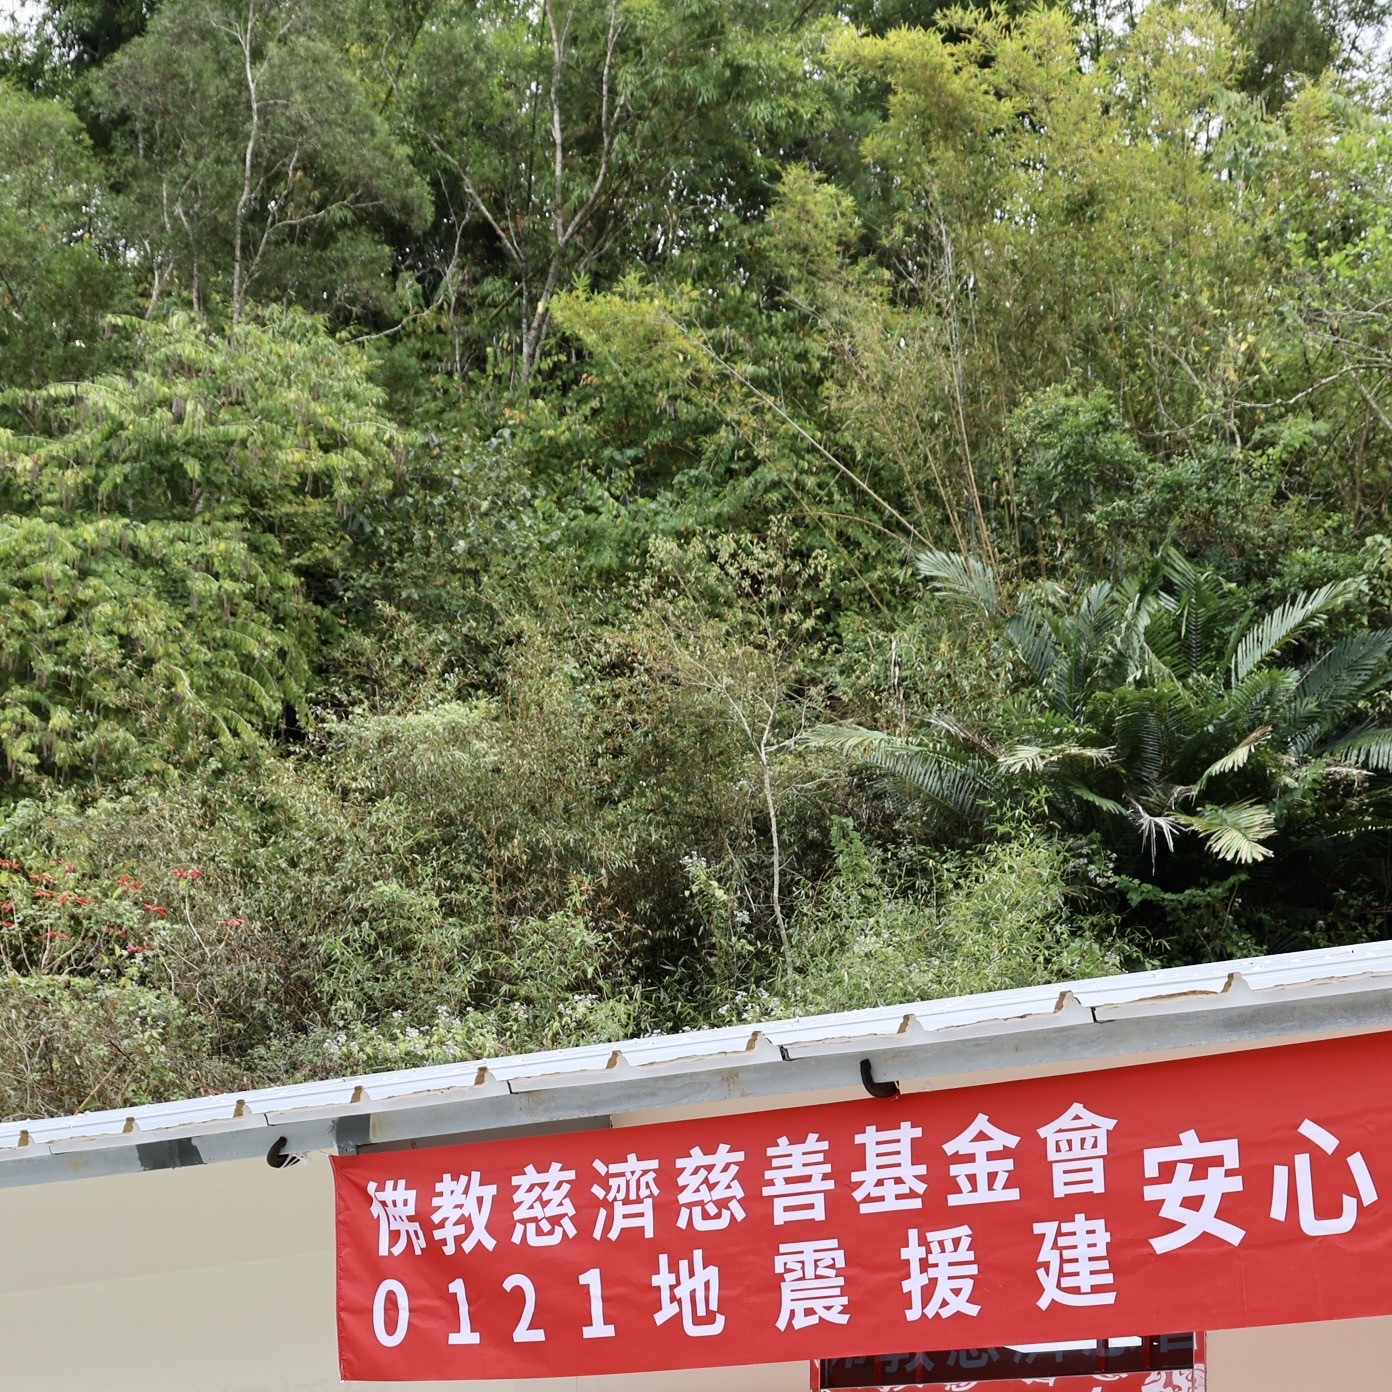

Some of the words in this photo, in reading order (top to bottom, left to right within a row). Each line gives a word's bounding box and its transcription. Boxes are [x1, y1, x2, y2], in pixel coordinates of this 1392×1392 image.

[368, 1101, 1119, 1257] 佛教慈濟慈善基金會
[373, 1213, 1117, 1347] 0121地震援建
